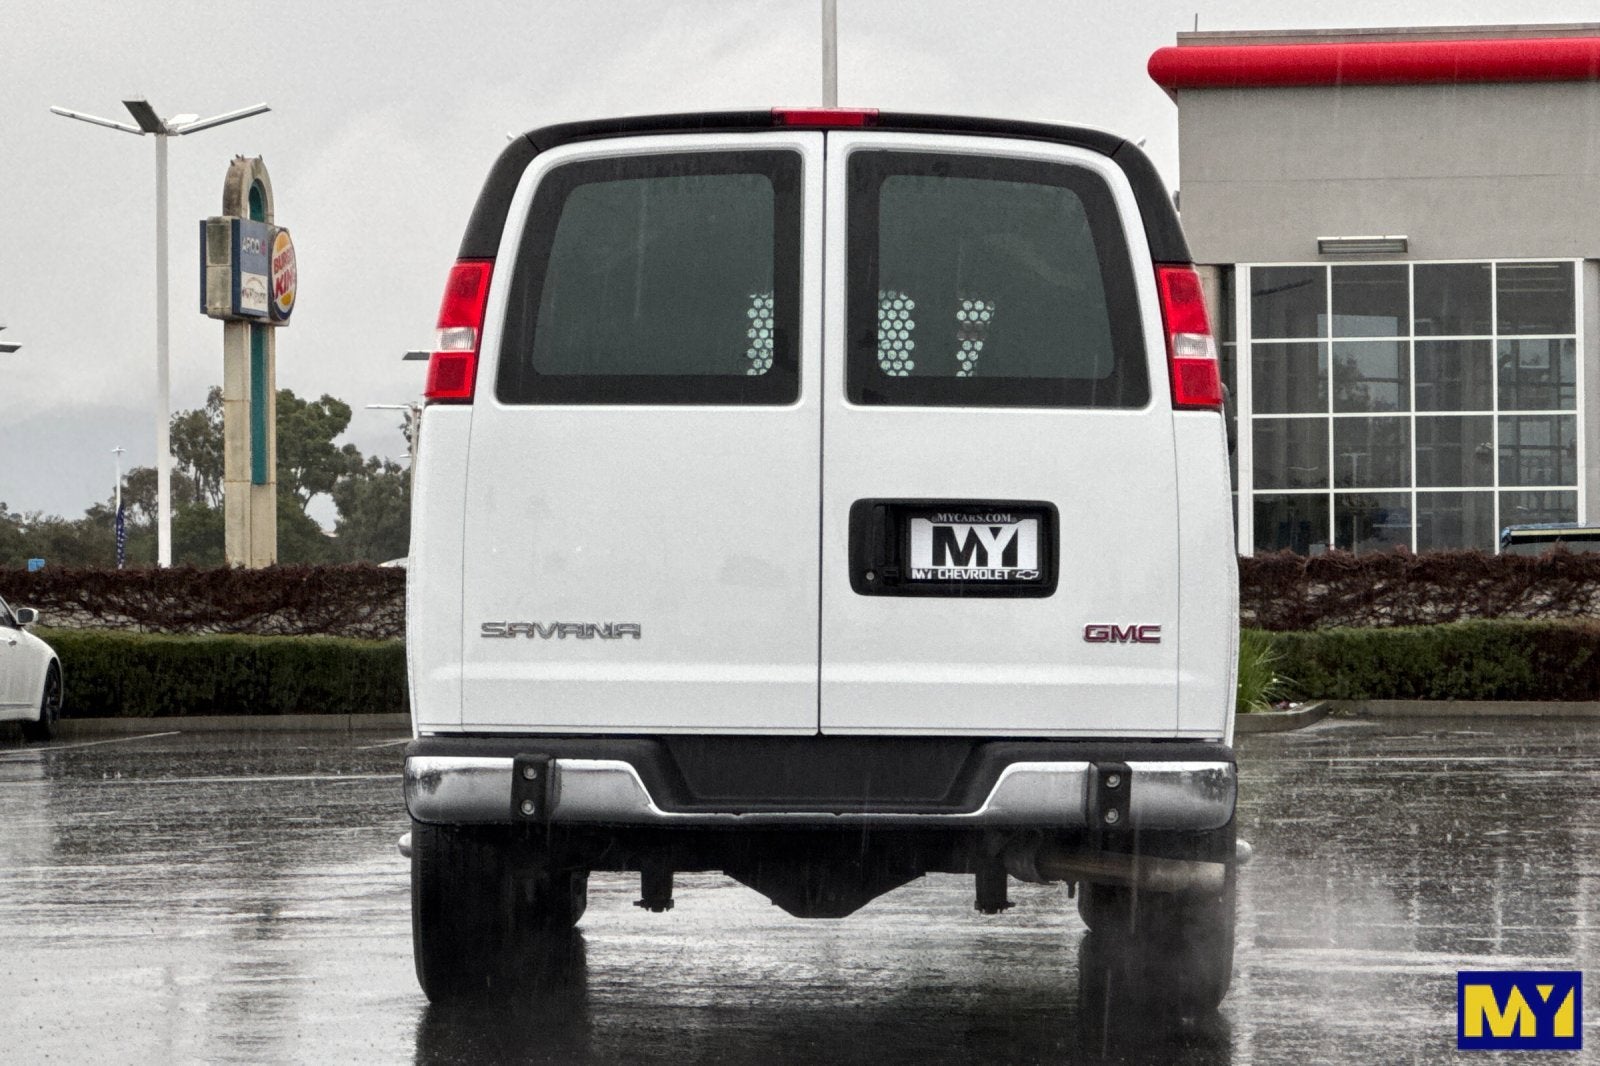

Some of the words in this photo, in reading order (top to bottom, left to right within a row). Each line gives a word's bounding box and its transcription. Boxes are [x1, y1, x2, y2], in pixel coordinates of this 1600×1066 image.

[937, 512, 1011, 522] MYCARS.COM
[932, 525, 1018, 567] MY
[937, 569, 1011, 580] CHEVROLET
[481, 621, 642, 640] SAVANA
[1084, 623, 1161, 643] GMC
